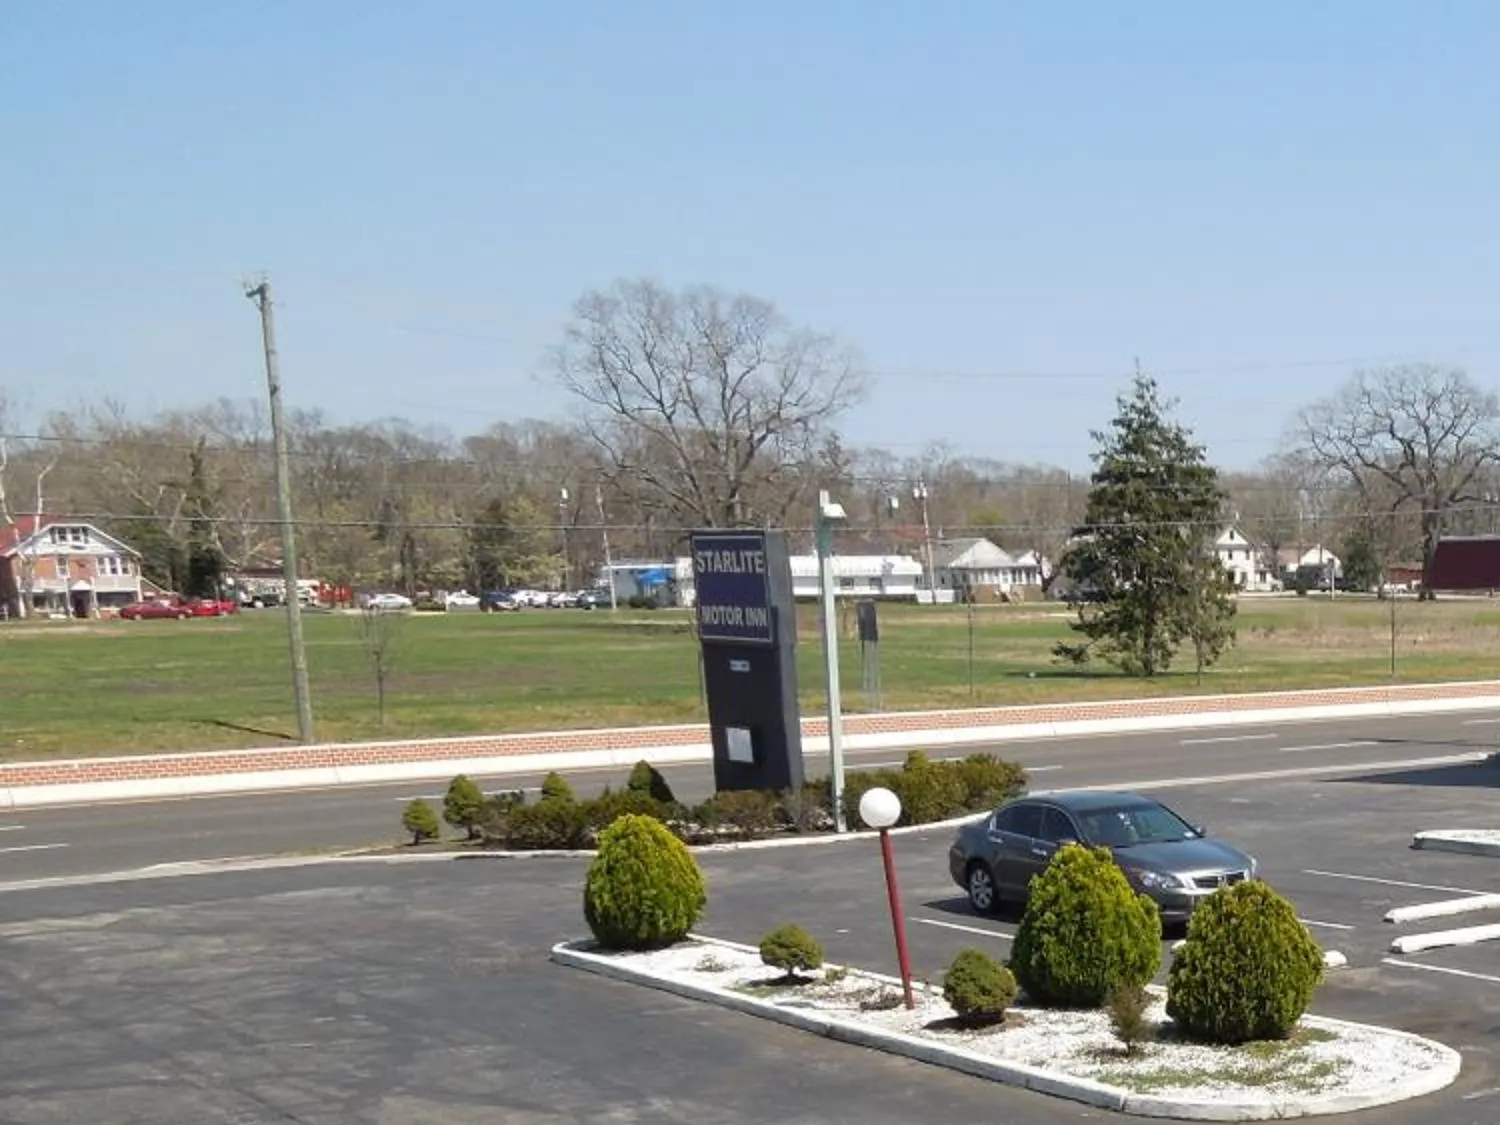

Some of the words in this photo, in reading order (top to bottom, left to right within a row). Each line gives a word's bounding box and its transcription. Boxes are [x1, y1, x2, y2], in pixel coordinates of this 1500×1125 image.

[697, 550, 765, 573] STARLITE
[702, 606, 744, 625] MOTOR
[746, 607, 767, 627] INN
